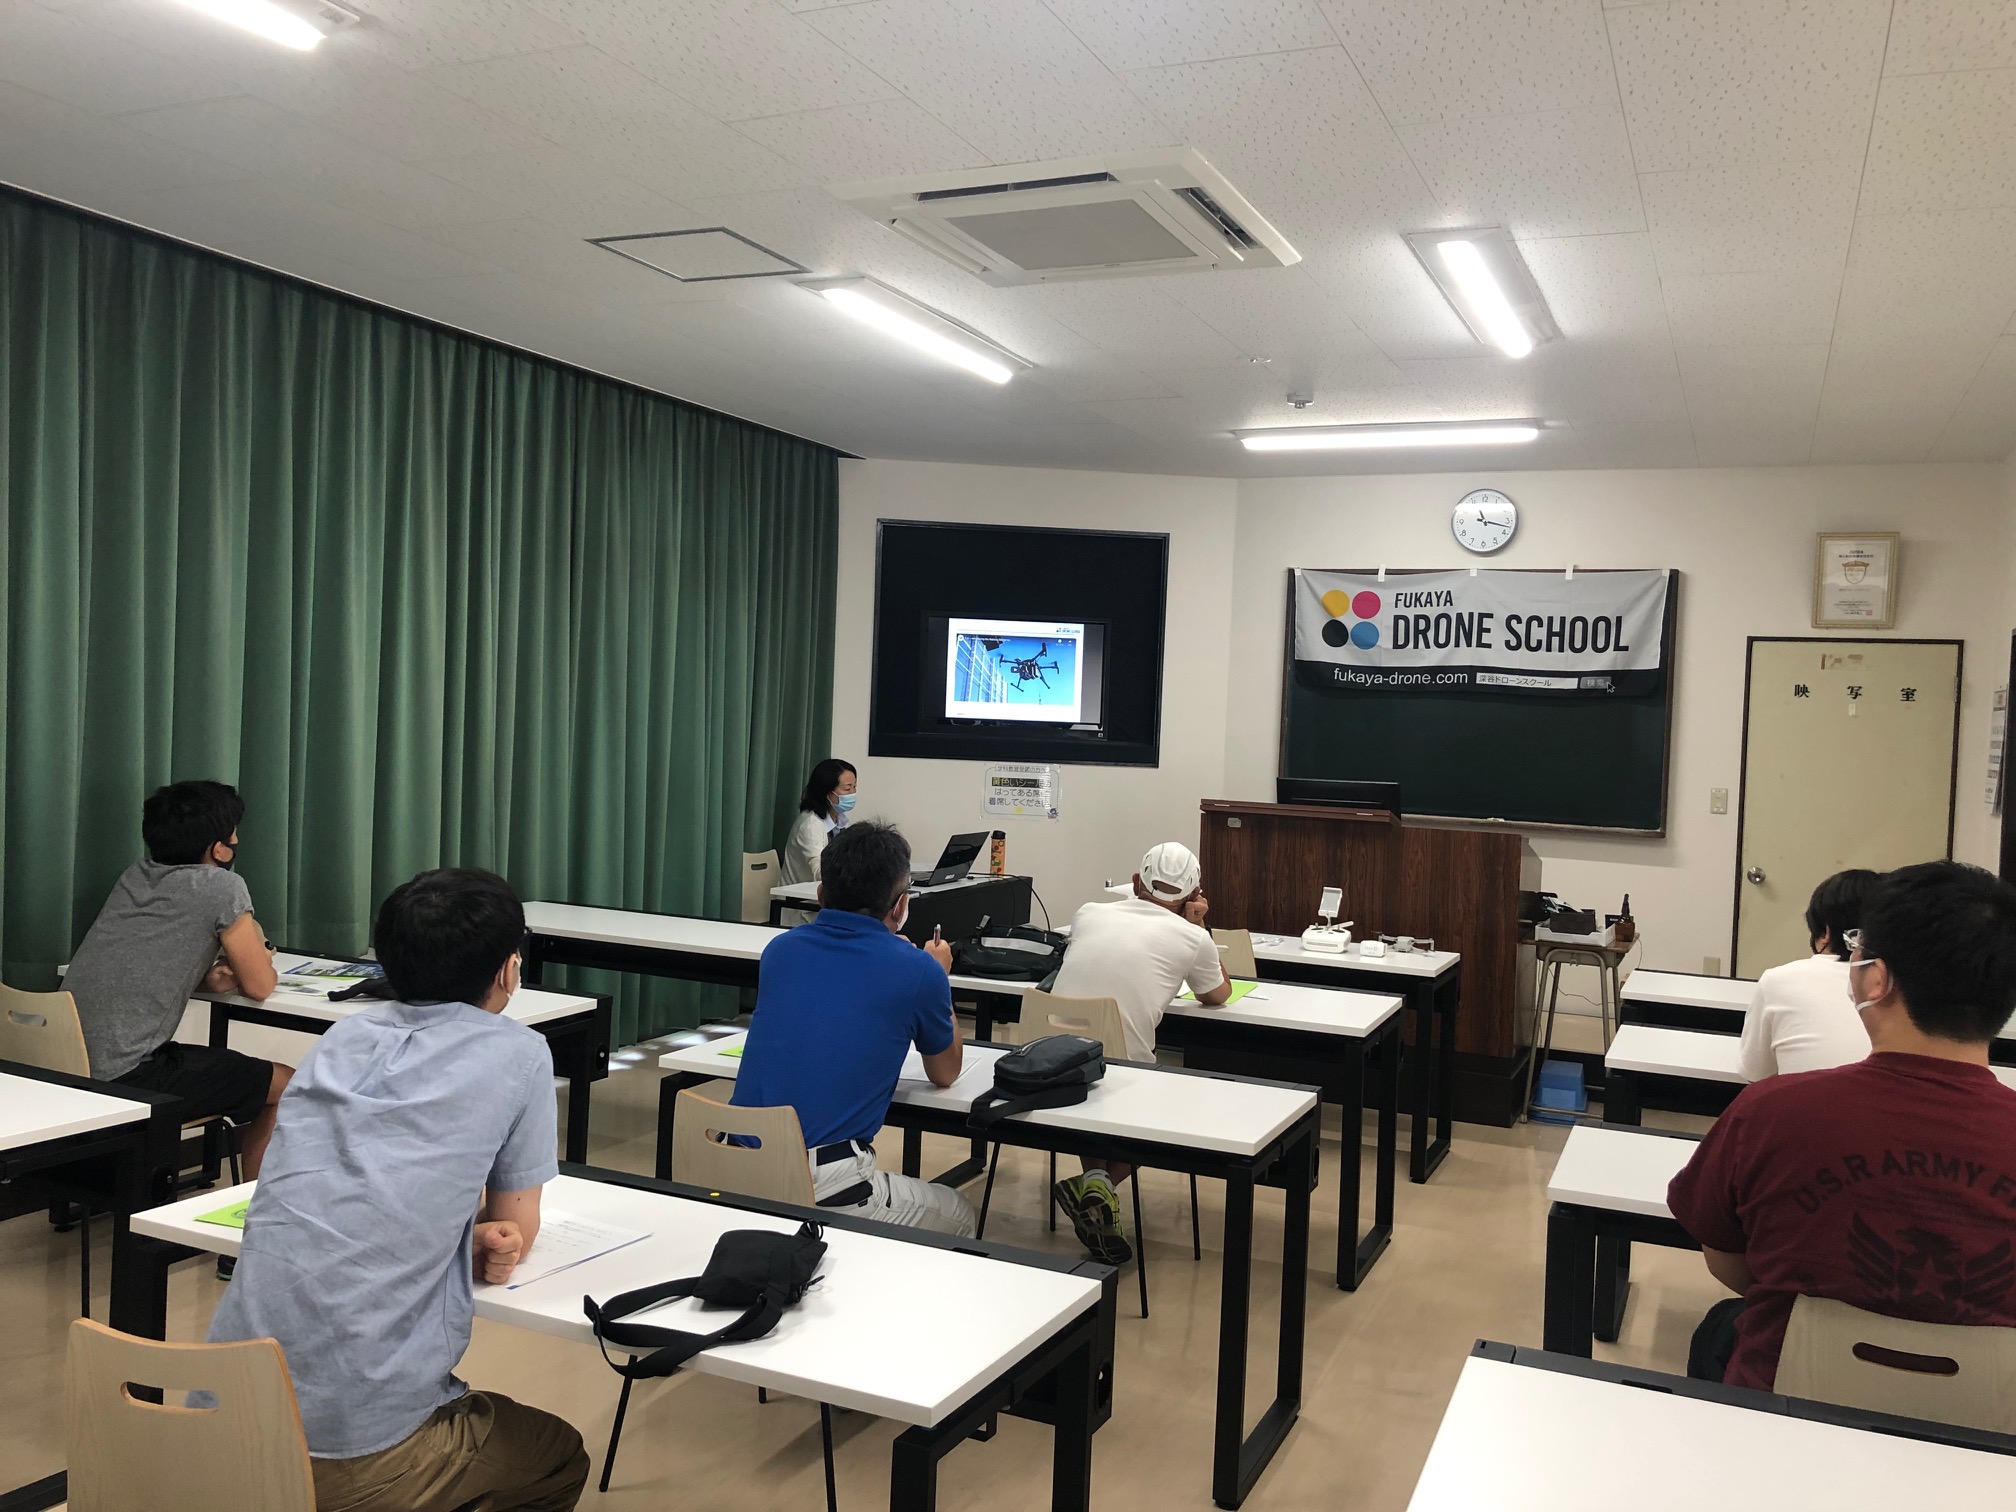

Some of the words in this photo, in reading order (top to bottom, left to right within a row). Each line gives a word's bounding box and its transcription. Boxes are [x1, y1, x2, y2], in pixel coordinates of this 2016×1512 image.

[1394, 590, 1454, 609] FUKAYA
[1392, 611, 1494, 650] DRONE
[1504, 614, 1630, 654] SCHOOL
[1333, 667, 1468, 686] fukaya-drone.com
[1880, 1148, 1987, 1188] ARMY
